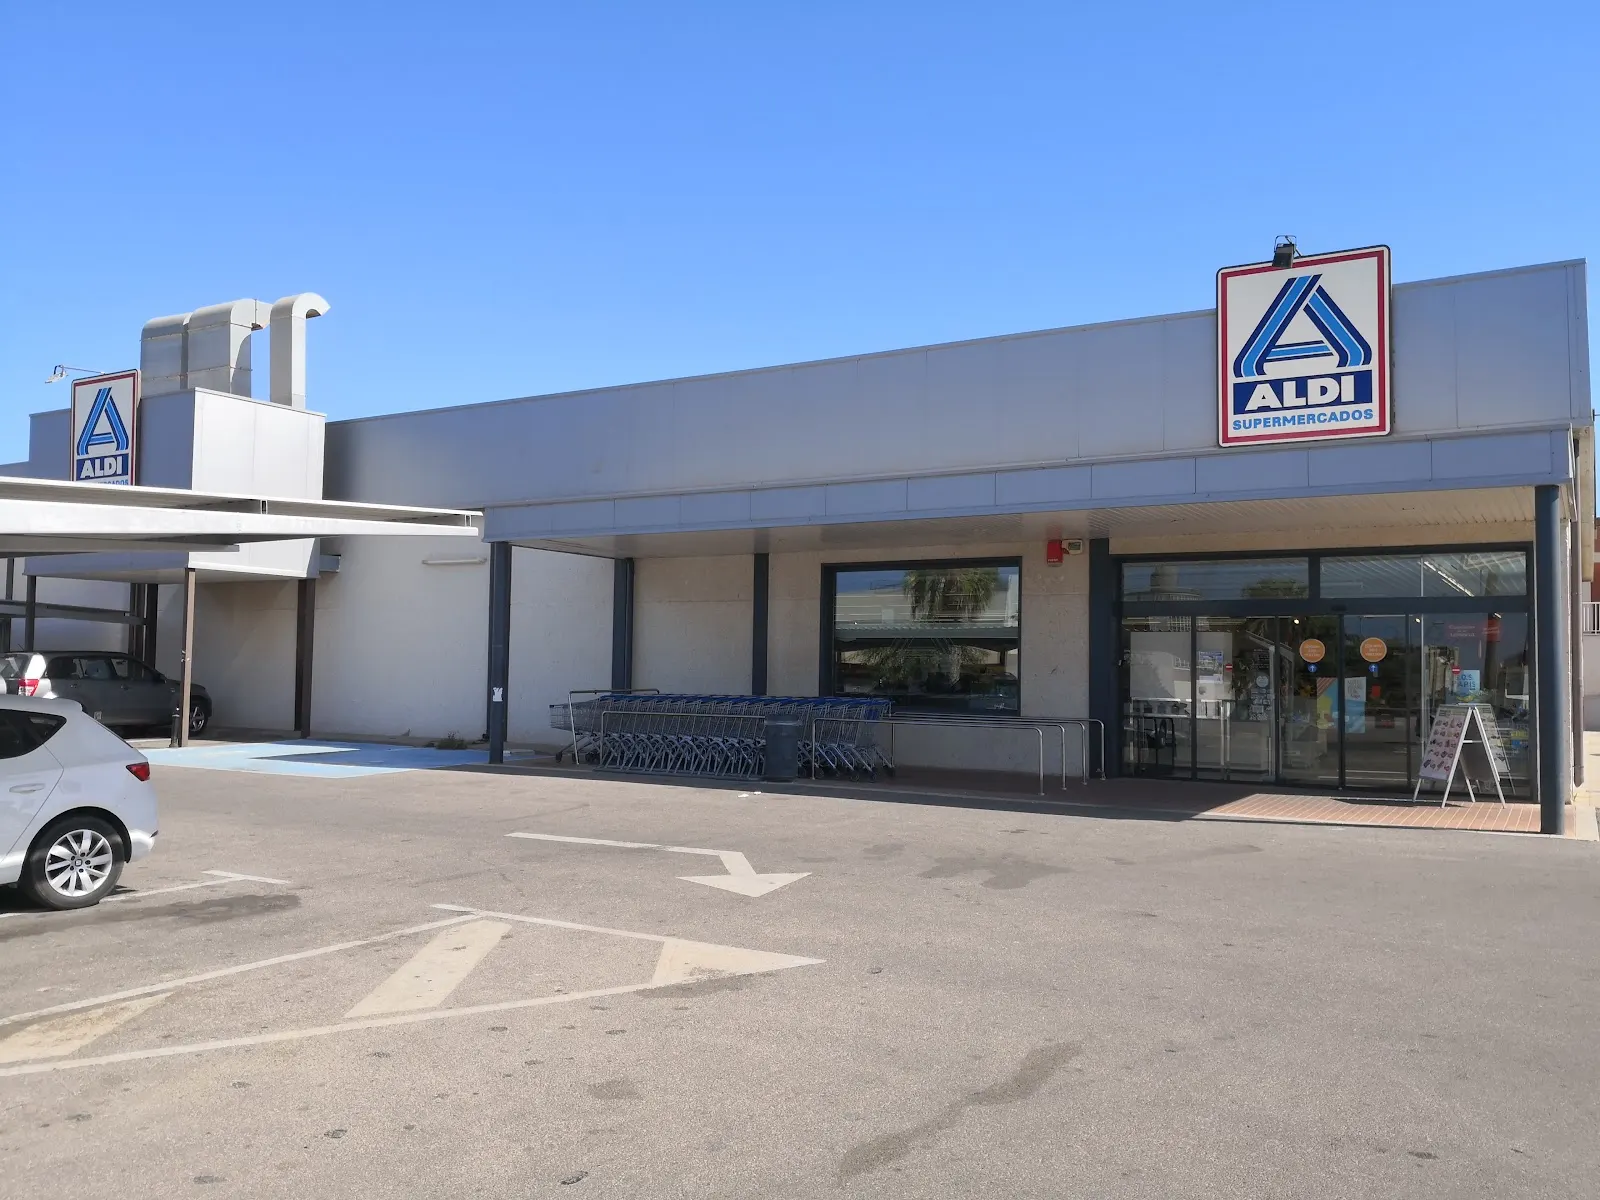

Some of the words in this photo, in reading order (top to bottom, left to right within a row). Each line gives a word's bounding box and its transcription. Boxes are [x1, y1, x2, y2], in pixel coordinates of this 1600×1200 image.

[1244, 375, 1355, 412] ALDI
[1232, 408, 1374, 430] SUPERMERCADOS
[80, 456, 123, 479] ALDI
